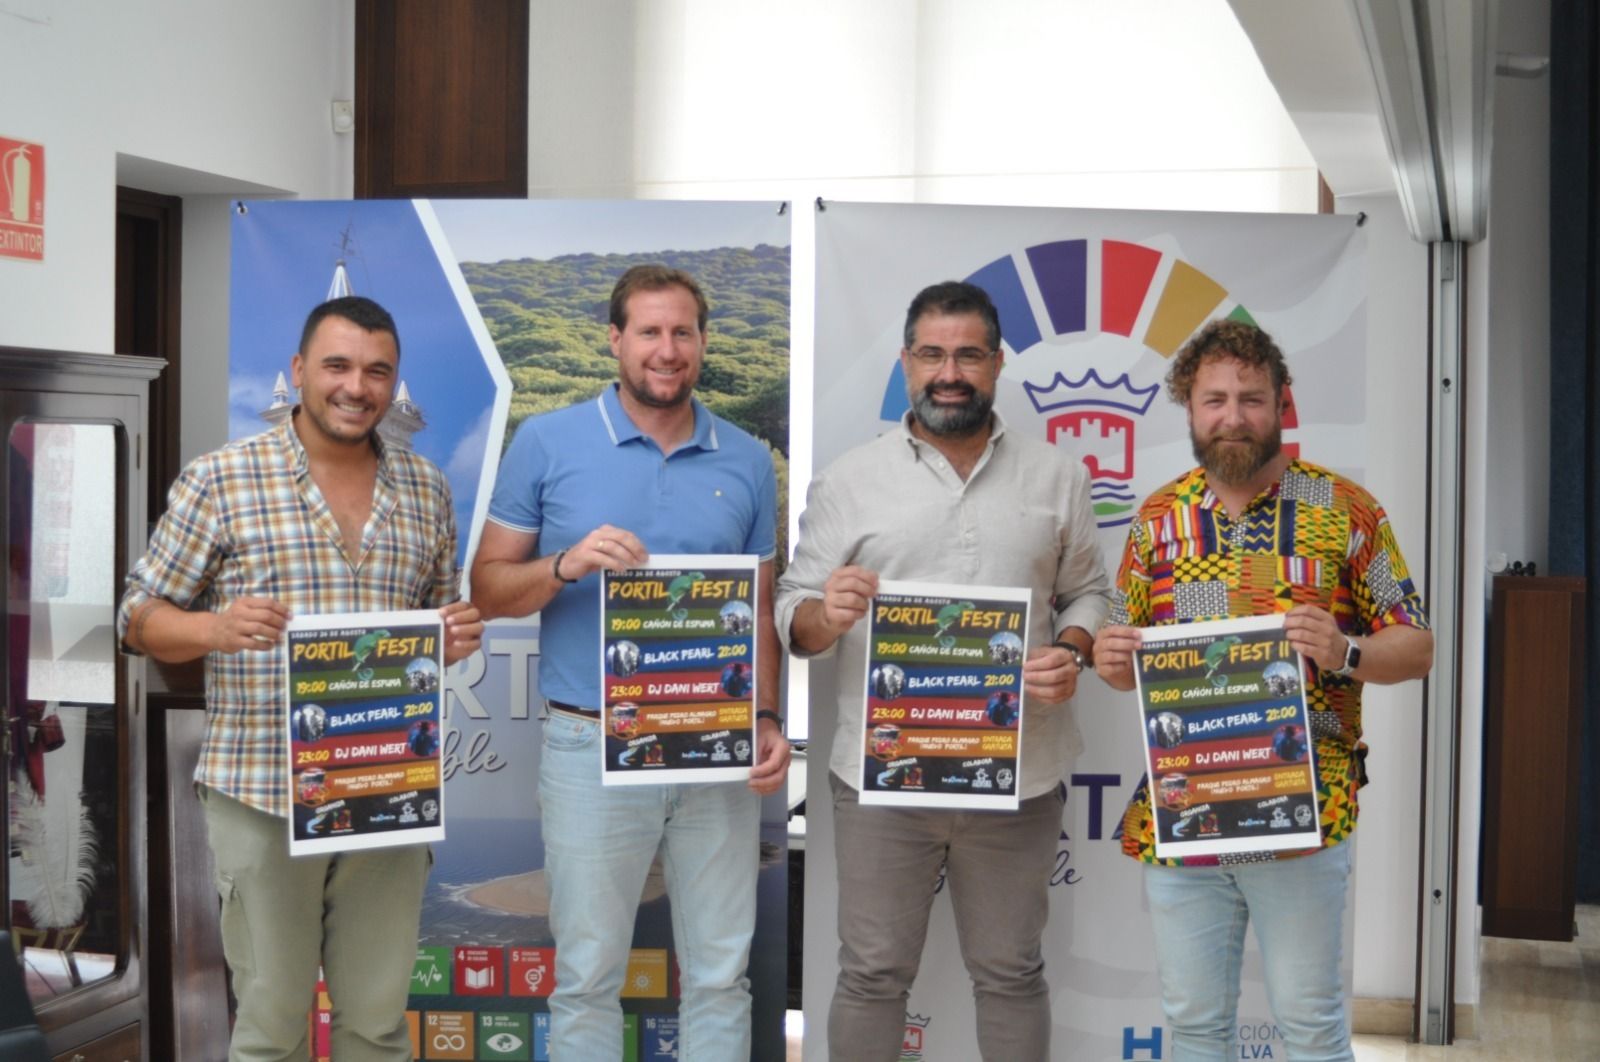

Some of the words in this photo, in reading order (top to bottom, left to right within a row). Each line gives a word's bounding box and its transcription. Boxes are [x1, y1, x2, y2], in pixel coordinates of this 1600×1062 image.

[608, 581, 670, 600] PORTIL
[691, 581, 734, 599] FEST
[737, 581, 749, 598] II
[611, 618, 642, 631] 19:00
[642, 619, 671, 630] CAÑÓN
[673, 620, 684, 629] DE
[685, 619, 715, 629] ESPUMA
[876, 606, 938, 625] PORTIL
[961, 610, 1005, 629] FEST
[1008, 613, 1020, 629] II
[293, 641, 355, 662] PORTIL
[377, 637, 420, 658] FEST
[424, 637, 434, 654] II
[644, 650, 679, 664] BLACK
[681, 647, 715, 660] PEARL
[877, 642, 907, 655] 19:00
[909, 645, 938, 655] CAÑÓN
[940, 647, 951, 655] DE
[952, 647, 983, 657] ESPUMA
[1142, 650, 1207, 672] PORTIL
[1229, 641, 1274, 664] FEST
[1278, 640, 1290, 658] II
[296, 681, 326, 695] 19:00
[328, 680, 357, 691] CAÑÓN
[359, 680, 370, 689] DE
[371, 678, 402, 689] ESPUMA
[908, 676, 944, 688] BLACK
[947, 675, 981, 687] PEARL
[610, 685, 643, 698] 23:00
[648, 684, 662, 695] DJ
[664, 683, 690, 695] DANI
[692, 682, 720, 694] WERT
[1149, 689, 1180, 703] 19:00
[1182, 687, 1212, 699] CAÑÓN
[1214, 687, 1226, 696] DE
[1227, 683, 1259, 695] ESPUMA
[330, 712, 365, 728] BLACK
[367, 707, 402, 721] PEARL
[872, 707, 905, 719] 23:00
[910, 708, 924, 719] DJ
[927, 708, 953, 719] DANI
[955, 709, 984, 721] WERT
[1188, 717, 1225, 734] BLACK
[1227, 712, 1263, 728] PEARL
[297, 750, 330, 764] 23:00
[335, 748, 348, 759] DJ
[351, 745, 377, 758] DANI
[380, 742, 407, 755] WERT
[1157, 756, 1190, 770] 23:00
[1195, 753, 1210, 764] DJ
[1213, 750, 1240, 763] DANI
[1243, 747, 1272, 760] WERT
[458, 950, 465, 961] 4
[512, 951, 519, 962] 5
[320, 1013, 330, 1024] 10
[428, 1015, 438, 1025] 12
[482, 1016, 493, 1027] 13
[536, 1017, 547, 1027] 14
[646, 1018, 656, 1029] 16
[1122, 1027, 1163, 1060] H
[1238, 1044, 1274, 1060] LVA
